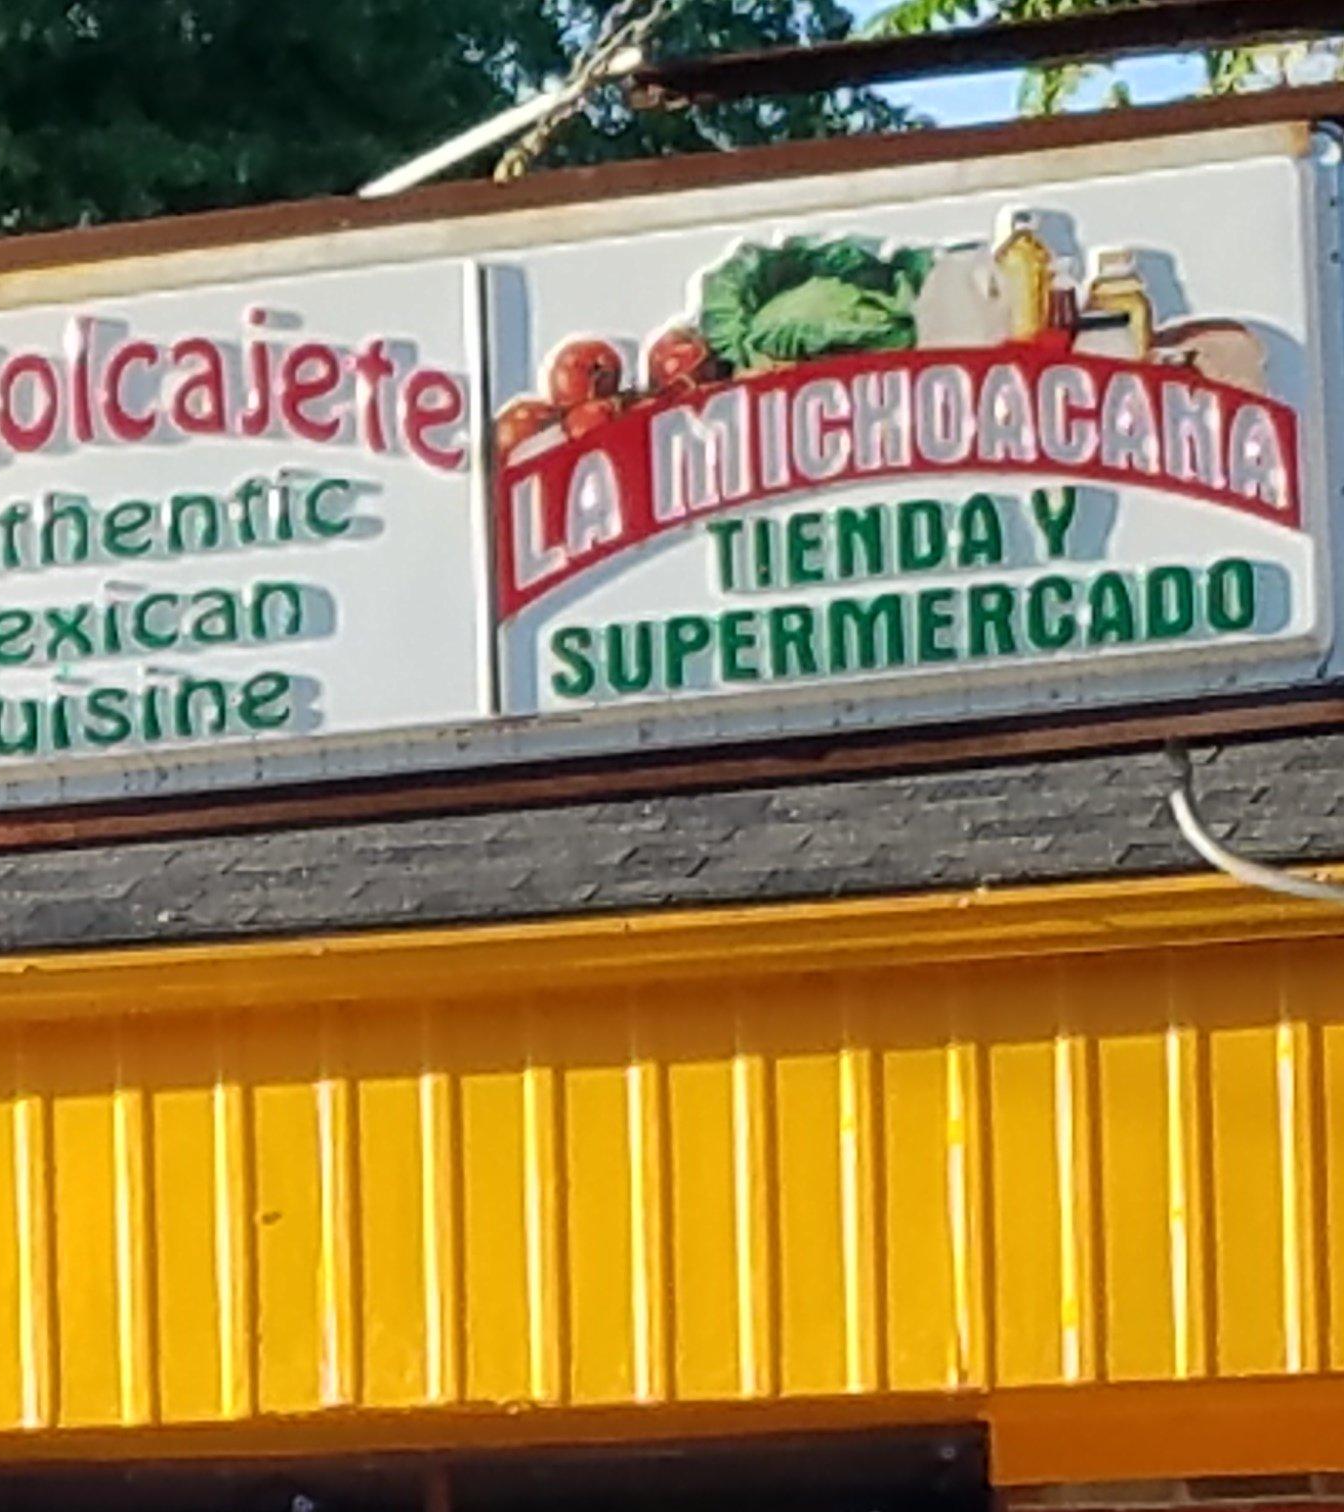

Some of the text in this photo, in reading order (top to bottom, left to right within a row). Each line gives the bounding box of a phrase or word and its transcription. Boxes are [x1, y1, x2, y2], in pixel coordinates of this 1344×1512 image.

[514, 363, 1291, 592] LA MICHOACANA
[708, 486, 1077, 593] TIENDA Y
[550, 557, 1256, 699] SUPERMERCADO
